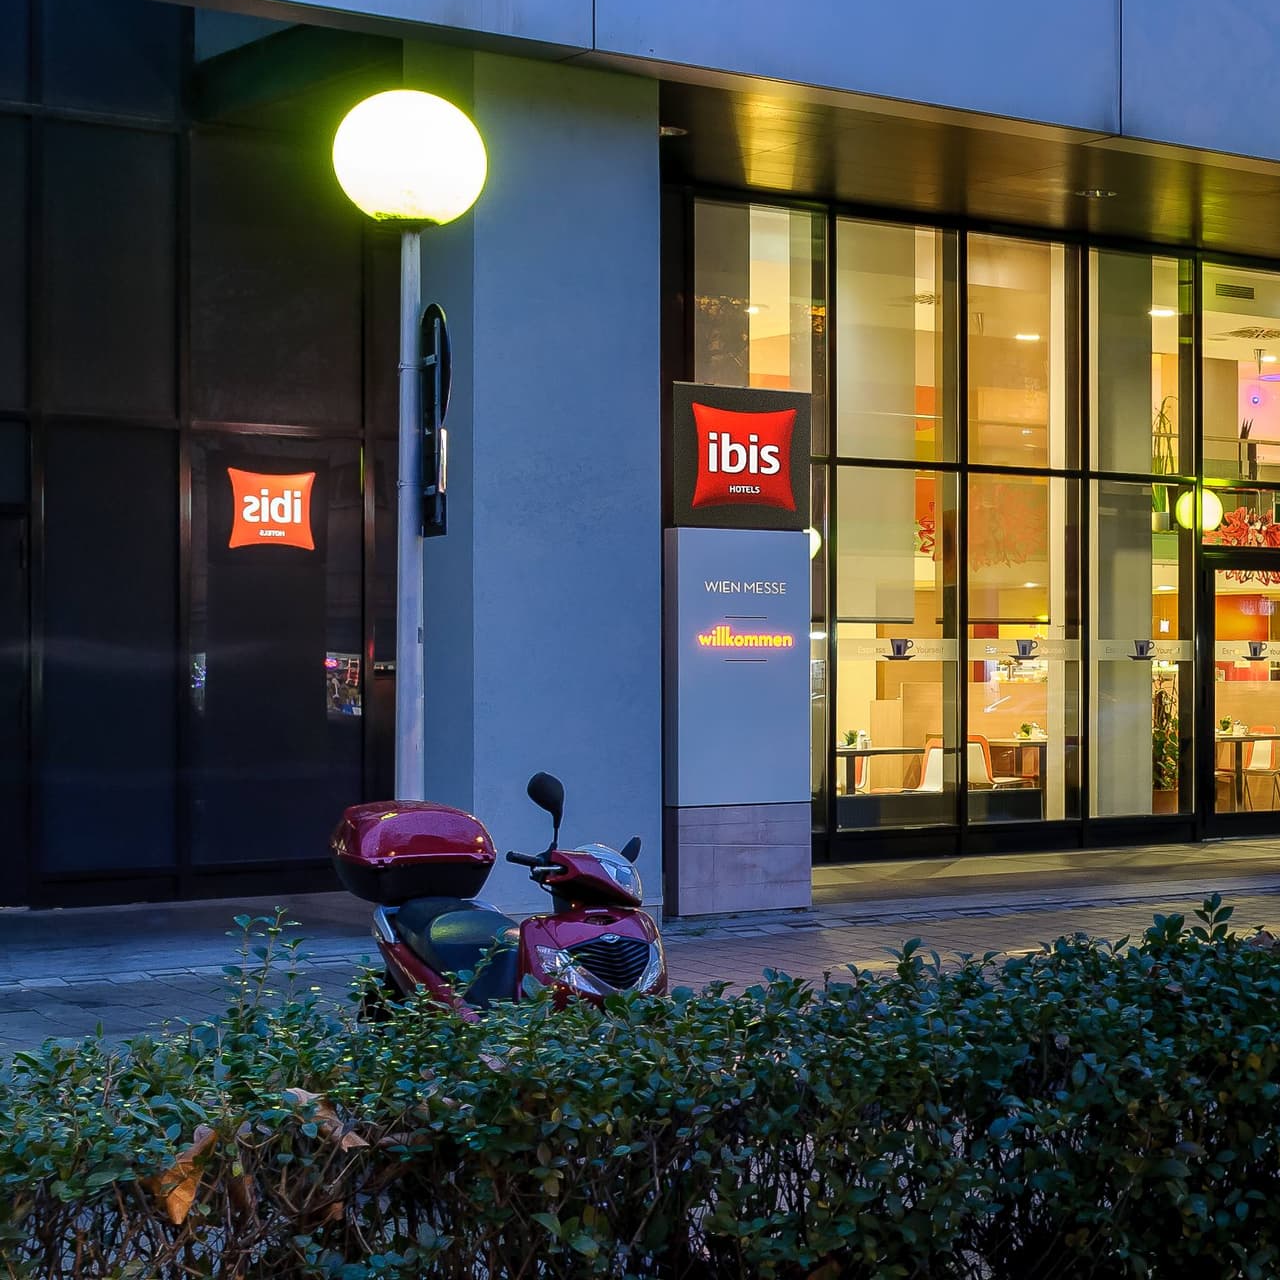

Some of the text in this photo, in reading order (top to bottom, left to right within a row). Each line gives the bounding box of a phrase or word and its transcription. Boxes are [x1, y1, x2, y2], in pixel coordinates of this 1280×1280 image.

[708, 431, 781, 475] ibis
[729, 485, 760, 494] HOTELS
[704, 580, 787, 595] WIEN MESSE
[698, 625, 793, 647] willkommen
